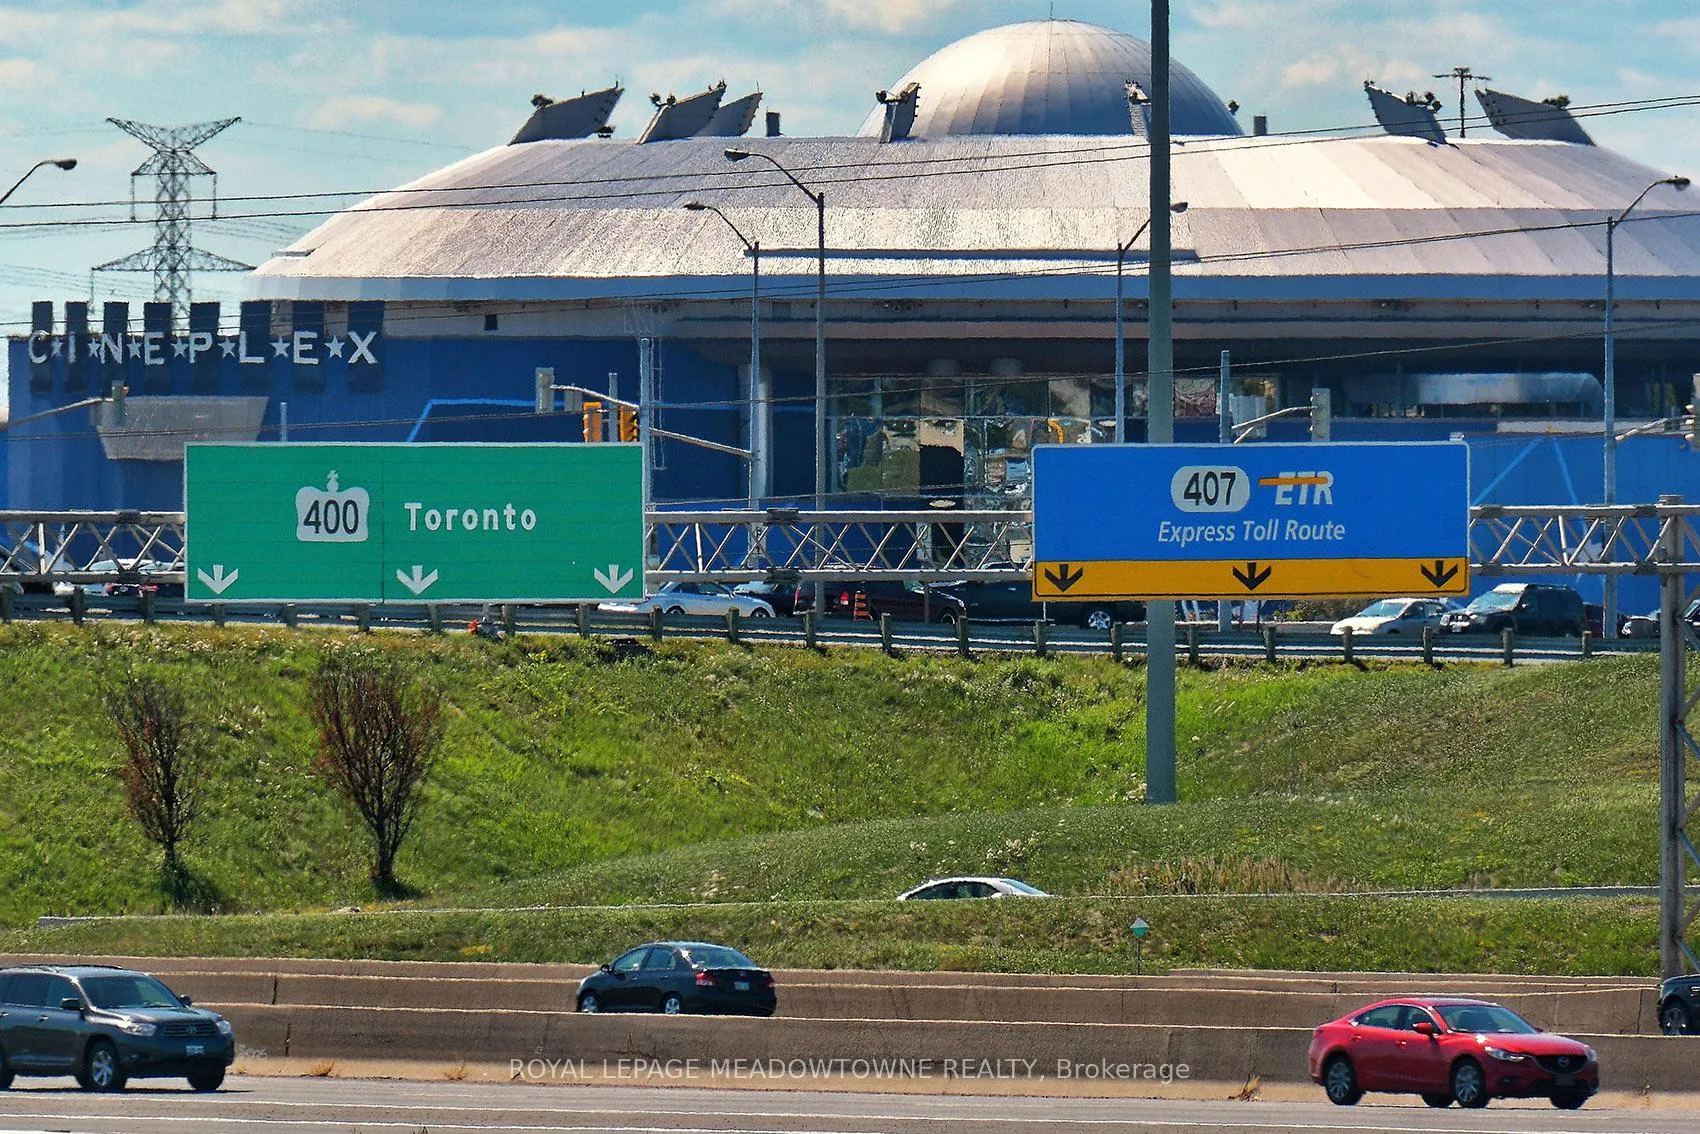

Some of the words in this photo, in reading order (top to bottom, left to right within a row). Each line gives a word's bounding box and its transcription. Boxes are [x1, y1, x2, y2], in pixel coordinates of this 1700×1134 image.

[28, 330, 378, 365] CINEPLEX
[1184, 472, 1236, 505] 407
[1275, 471, 1334, 505] ETR
[303, 499, 359, 534] 400
[404, 503, 536, 531] Toronto
[1159, 521, 1235, 547] Express
[1243, 519, 1279, 541] Toll
[1285, 520, 1345, 540] Route
